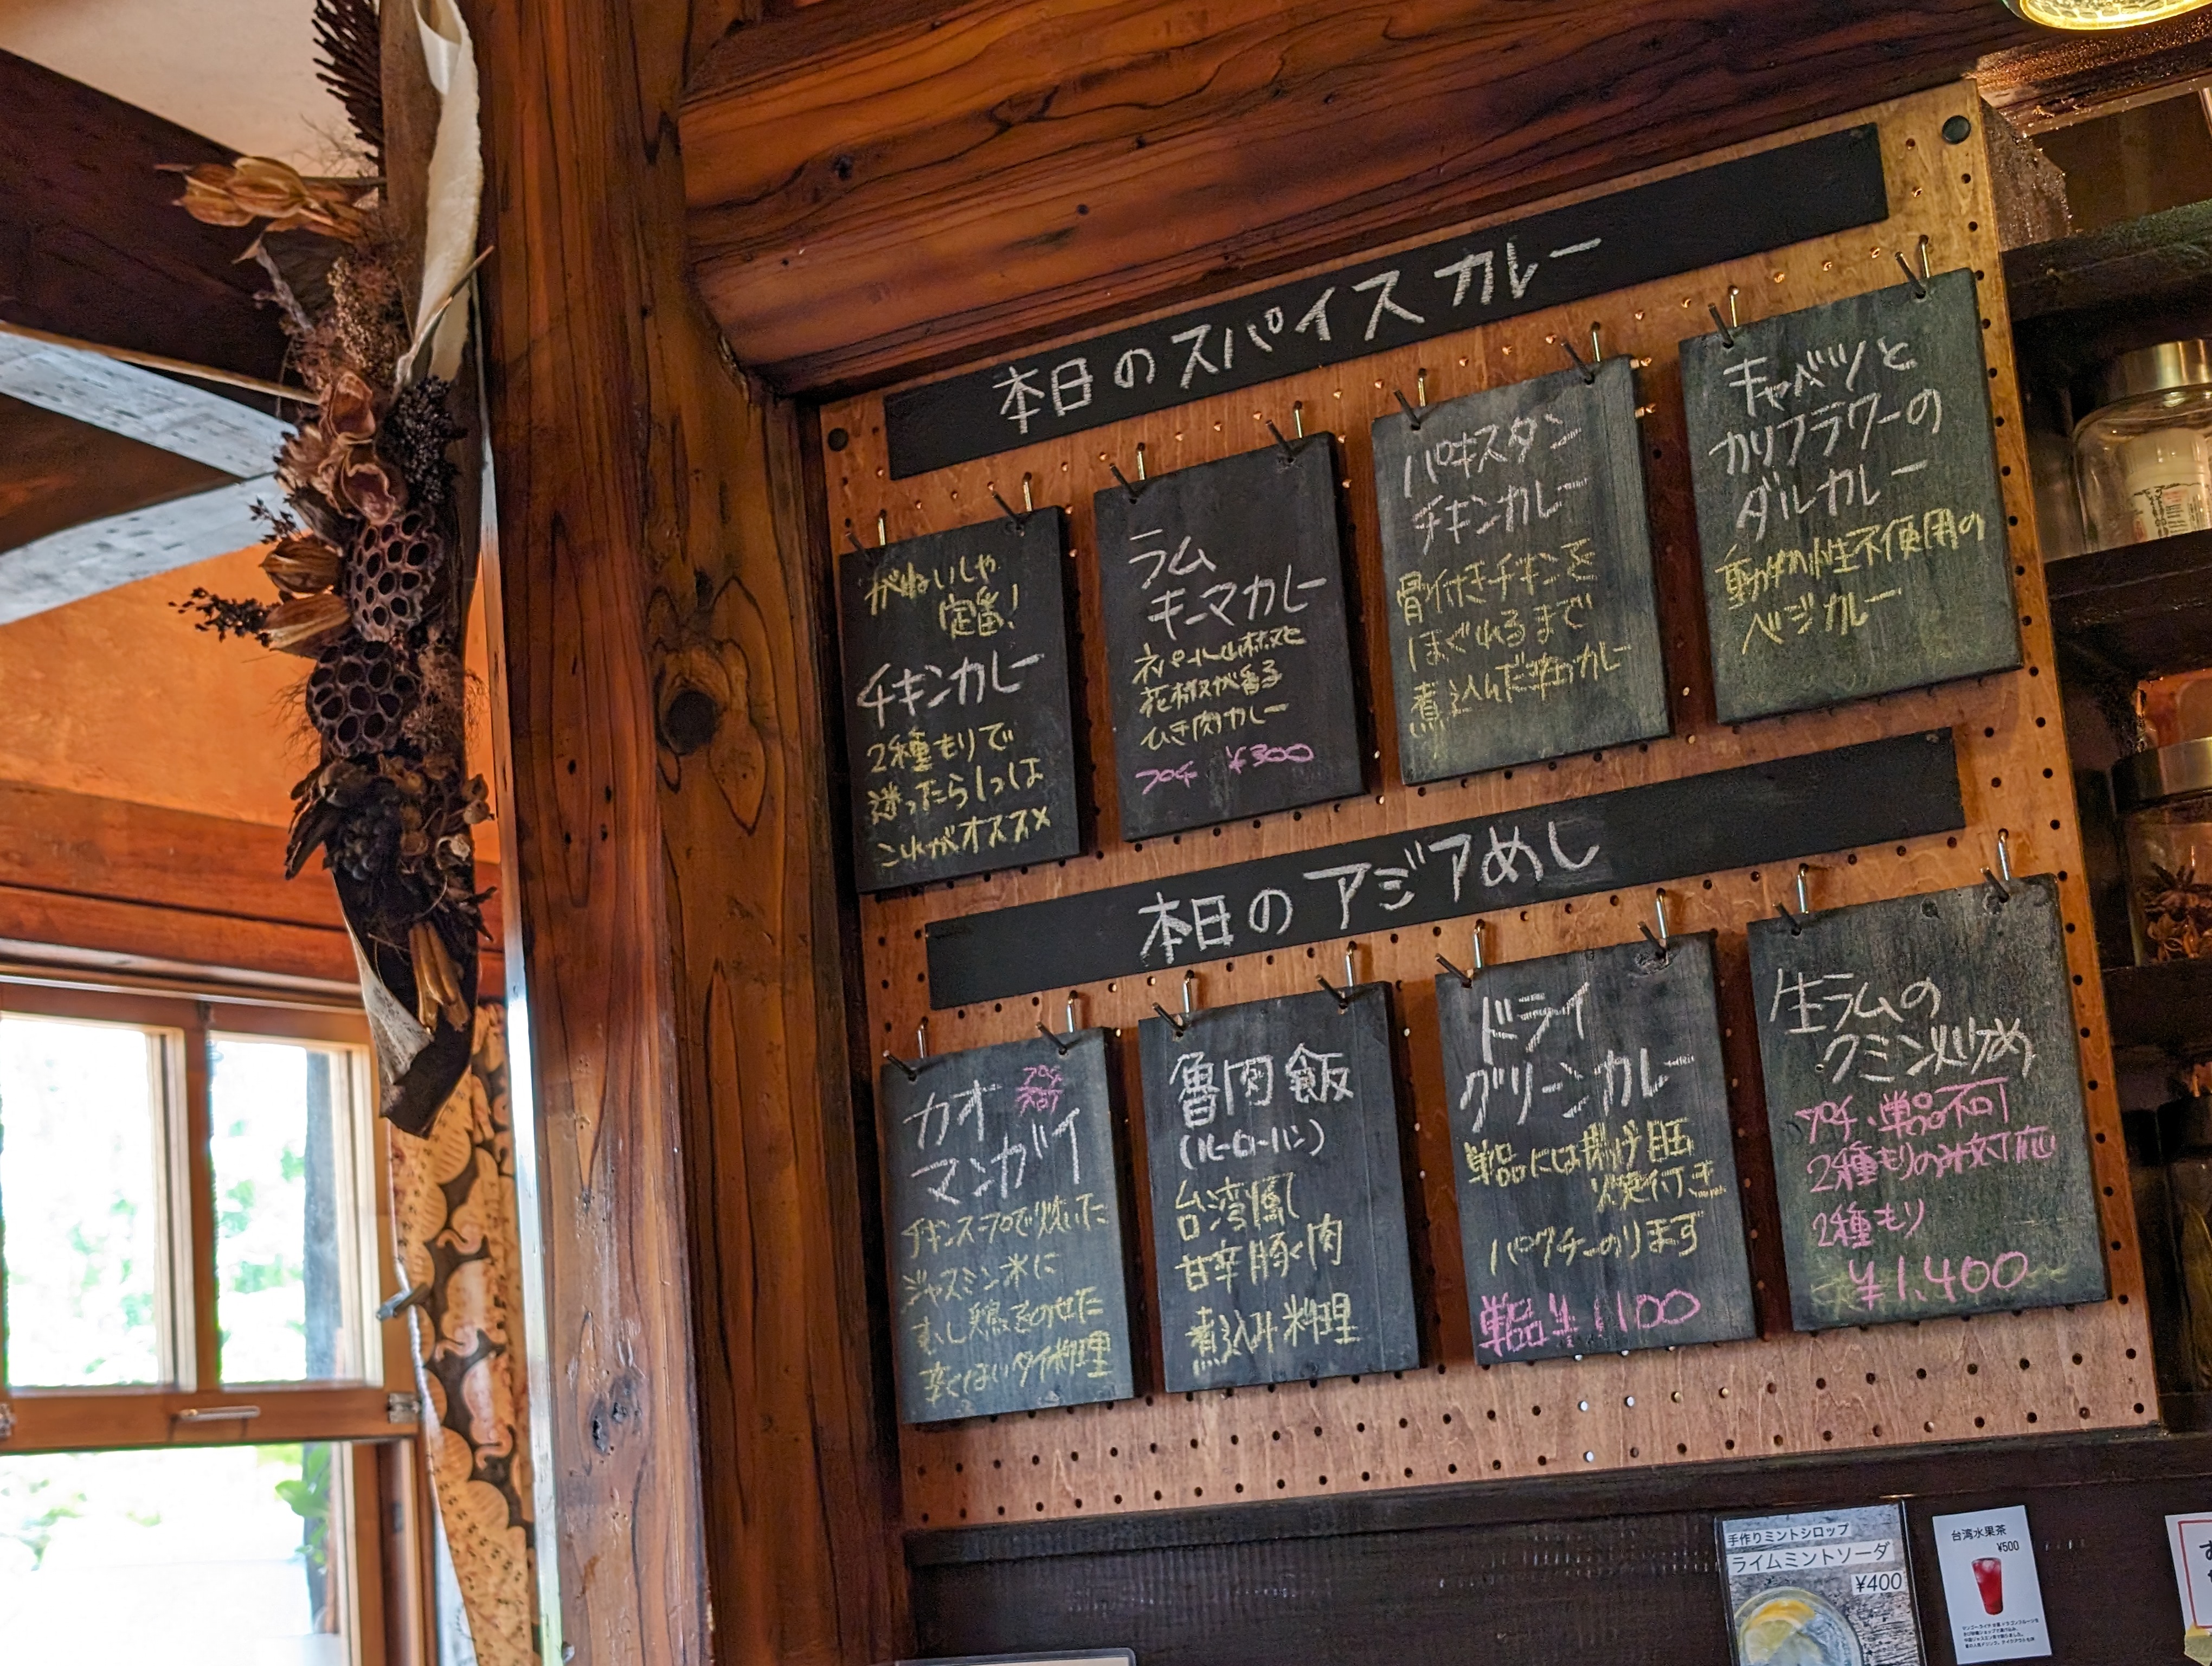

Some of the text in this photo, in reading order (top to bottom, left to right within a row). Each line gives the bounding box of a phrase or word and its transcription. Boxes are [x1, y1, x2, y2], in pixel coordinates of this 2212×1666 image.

[1723, 336, 1917, 418] キャベツと
[1404, 413, 1582, 498] パキスタン
[1708, 388, 1942, 475] カリフラワーの
[1412, 477, 1589, 555] チキンカレー
[1736, 459, 1928, 542] ダルカレー
[1129, 528, 1217, 589] ラム
[1397, 537, 1597, 626] 骨付きチキンを
[1714, 508, 1985, 610] 動物性不使用の
[1147, 564, 1327, 641] キーマカレー
[1409, 592, 1594, 672] ほぐれるまで
[1741, 587, 1902, 655] ベジカレー
[857, 650, 1044, 729] チキンカレー
[1140, 659, 1282, 718] 花椒が香る
[867, 722, 1014, 773] 2種もりで
[1141, 703, 1289, 751] ひき肉カレー
[878, 805, 1051, 867] これがオススメ
[1139, 821, 1599, 965] 本日のアジアめし
[1481, 981, 1590, 1066] ドライ
[1769, 968, 1941, 1034] 生ラムの
[1169, 1042, 1354, 1128] 魯肉飯
[1817, 1016, 2033, 1084] クミン炒め
[903, 1079, 1002, 1149] カオ
[1460, 1048, 1695, 1133] グリーンカレー
[910, 1107, 1081, 1204] マンガイ
[1806, 1124, 2056, 1193] 2種もりのみ対応
[1175, 1171, 1300, 1241] 台湾風
[1812, 1198, 1925, 1249] 2種もり
[1491, 1210, 1704, 1276] パクチーのります
[902, 1252, 1060, 1307] ジャスミン米に
[1185, 1292, 1361, 1375] 煮込み料理
[1728, 1523, 1849, 1546] 手作りミントシロップ
[1732, 1541, 1890, 1573] ライムミントソーダ
[1951, 1524, 2007, 1542] 台湾水果茶
[1997, 1541, 2020, 1552] ¥500
[1855, 1573, 1902, 1592] ¥400
